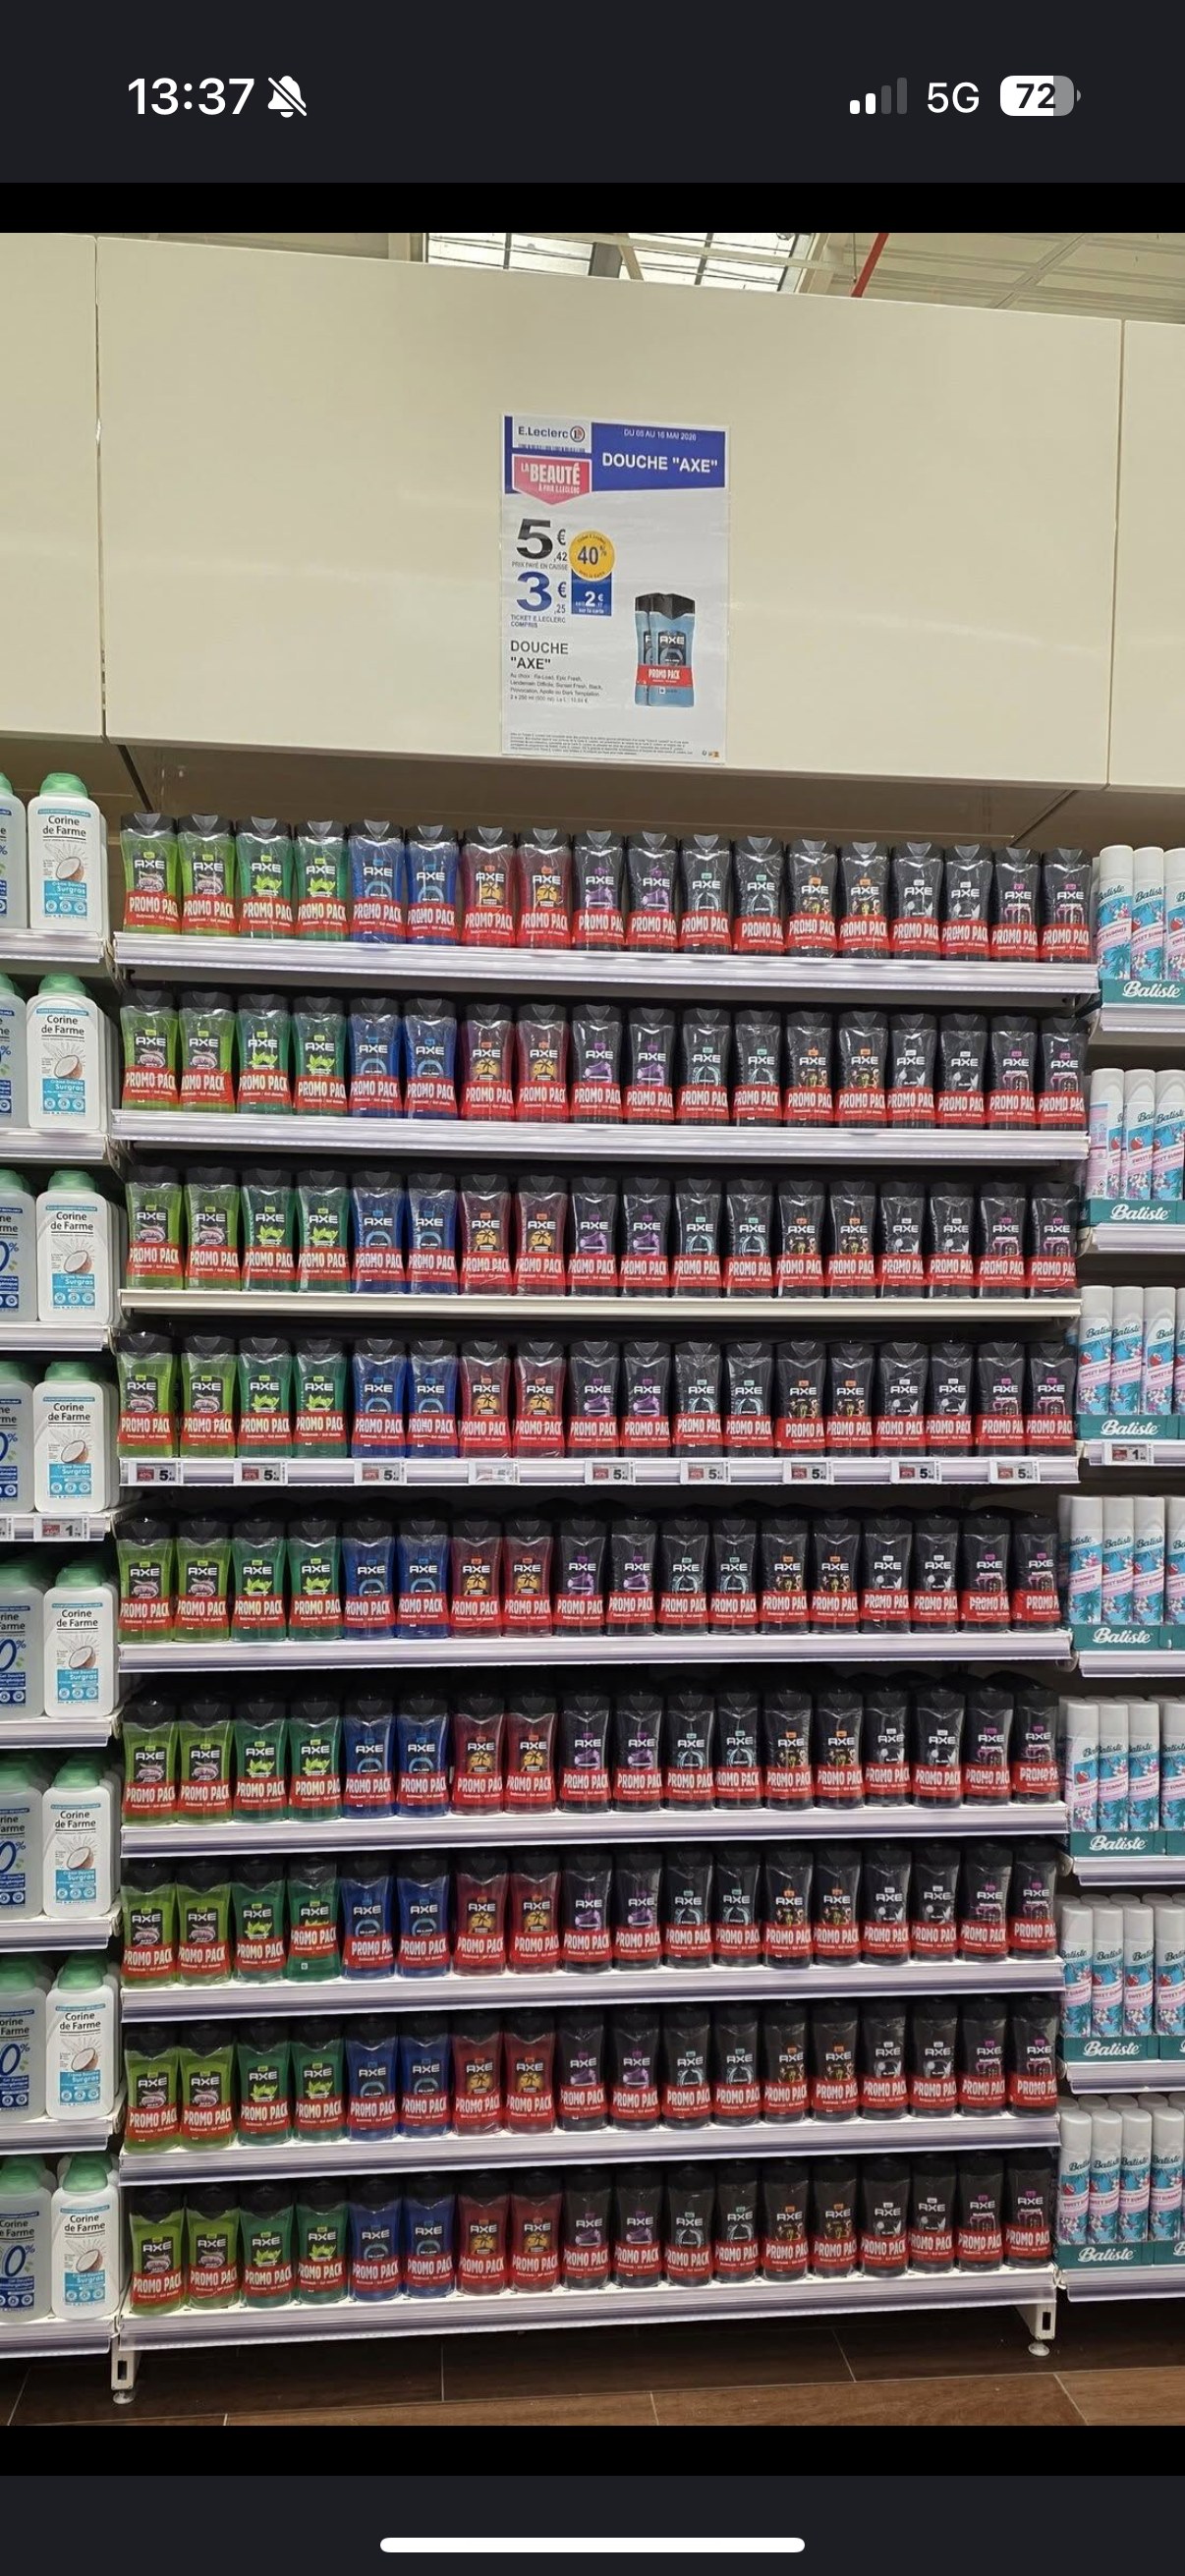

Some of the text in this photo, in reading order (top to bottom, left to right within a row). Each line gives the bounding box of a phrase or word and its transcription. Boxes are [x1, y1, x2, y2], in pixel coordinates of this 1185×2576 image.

[518, 425, 569, 439] E.Leclerc
[602, 452, 718, 474] DOUCHE "AXE"
[530, 462, 581, 485] BEAUTÉ
[517, 519, 553, 559] 5
[557, 529, 566, 545] €
[517, 571, 552, 612] 3
[558, 582, 566, 598] €
[586, 591, 595, 607] 2
[659, 636, 684, 644] AXE
[510, 640, 569, 654] DOUCHE
[510, 656, 551, 670] "AXE"
[649, 669, 680, 680] PROMO PACK
[48, 815, 80, 825] Corine
[43, 825, 86, 837] de Farme
[364, 867, 393, 877] AXE
[533, 875, 561, 884] AXE
[57, 886, 85, 895] Surgras
[354, 905, 402, 923] PROMO PACK
[521, 914, 567, 930] PROMO PACK
[1122, 980, 1181, 998] Batiste
[47, 1015, 78, 1025] Corine
[55, 1026, 85, 1036] Farme
[416, 1046, 445, 1055] AXE
[55, 1084, 84, 1092] Surgras
[407, 1082, 454, 1098] PROMO PACK
[57, 1211, 86, 1220] Corine
[137, 1211, 166, 1221] AXE
[1110, 1204, 1168, 1220] Batiste
[51, 1221, 93, 1231] de Farme
[634, 1222, 661, 1231] AXE
[130, 1248, 179, 1264] PROMO PACK
[621, 1259, 667, 1274] PROMO PACK
[305, 1382, 333, 1391] AXE
[54, 1403, 84, 1412] Corine
[62, 1413, 90, 1422] Farme
[297, 1417, 343, 1432] PROMO PACK
[877, 1421, 924, 1435] PROMO PACK
[1100, 1420, 1158, 1435] Batiste
[159, 1470, 168, 1481] 5
[263, 1470, 272, 1481] 5
[383, 1470, 392, 1481] 5
[613, 1470, 621, 1480] 5
[708, 1470, 716, 1480] 5
[812, 1469, 819, 1479] 5
[920, 1469, 928, 1479] 5
[1018, 1469, 1026, 1479] 5
[65, 1525, 73, 1537] 1
[243, 1566, 272, 1575] AXE
[235, 1599, 283, 1616] PROMO PACK
[557, 1600, 603, 1616] PROMO PACK
[62, 1609, 91, 1618] Corine
[70, 1618, 98, 1627] Farme
[1093, 1628, 1151, 1643] Batiste
[617, 1773, 662, 1788] PROMO PACK
[1090, 1835, 1146, 1851] Batiste
[875, 1893, 903, 1902] AXE
[410, 1905, 437, 1914] AXE
[865, 1927, 909, 1942] PROMO PACK
[401, 1937, 446, 1954] PROMO PACK
[65, 2012, 94, 2021] Corine
[73, 2021, 100, 2030] Farme
[875, 2046, 901, 2056] AXE
[1083, 2042, 1139, 2056] Batiste
[359, 2067, 385, 2077] AXE
[864, 2079, 906, 2097] PROMO PACK
[351, 2099, 395, 2117] PROMO PACK
[65, 2222, 105, 2232] de Farme
[362, 2229, 392, 2240] AXE
[1078, 2247, 1134, 2262] Batiste
[353, 2260, 399, 2278] PROMO PACK
